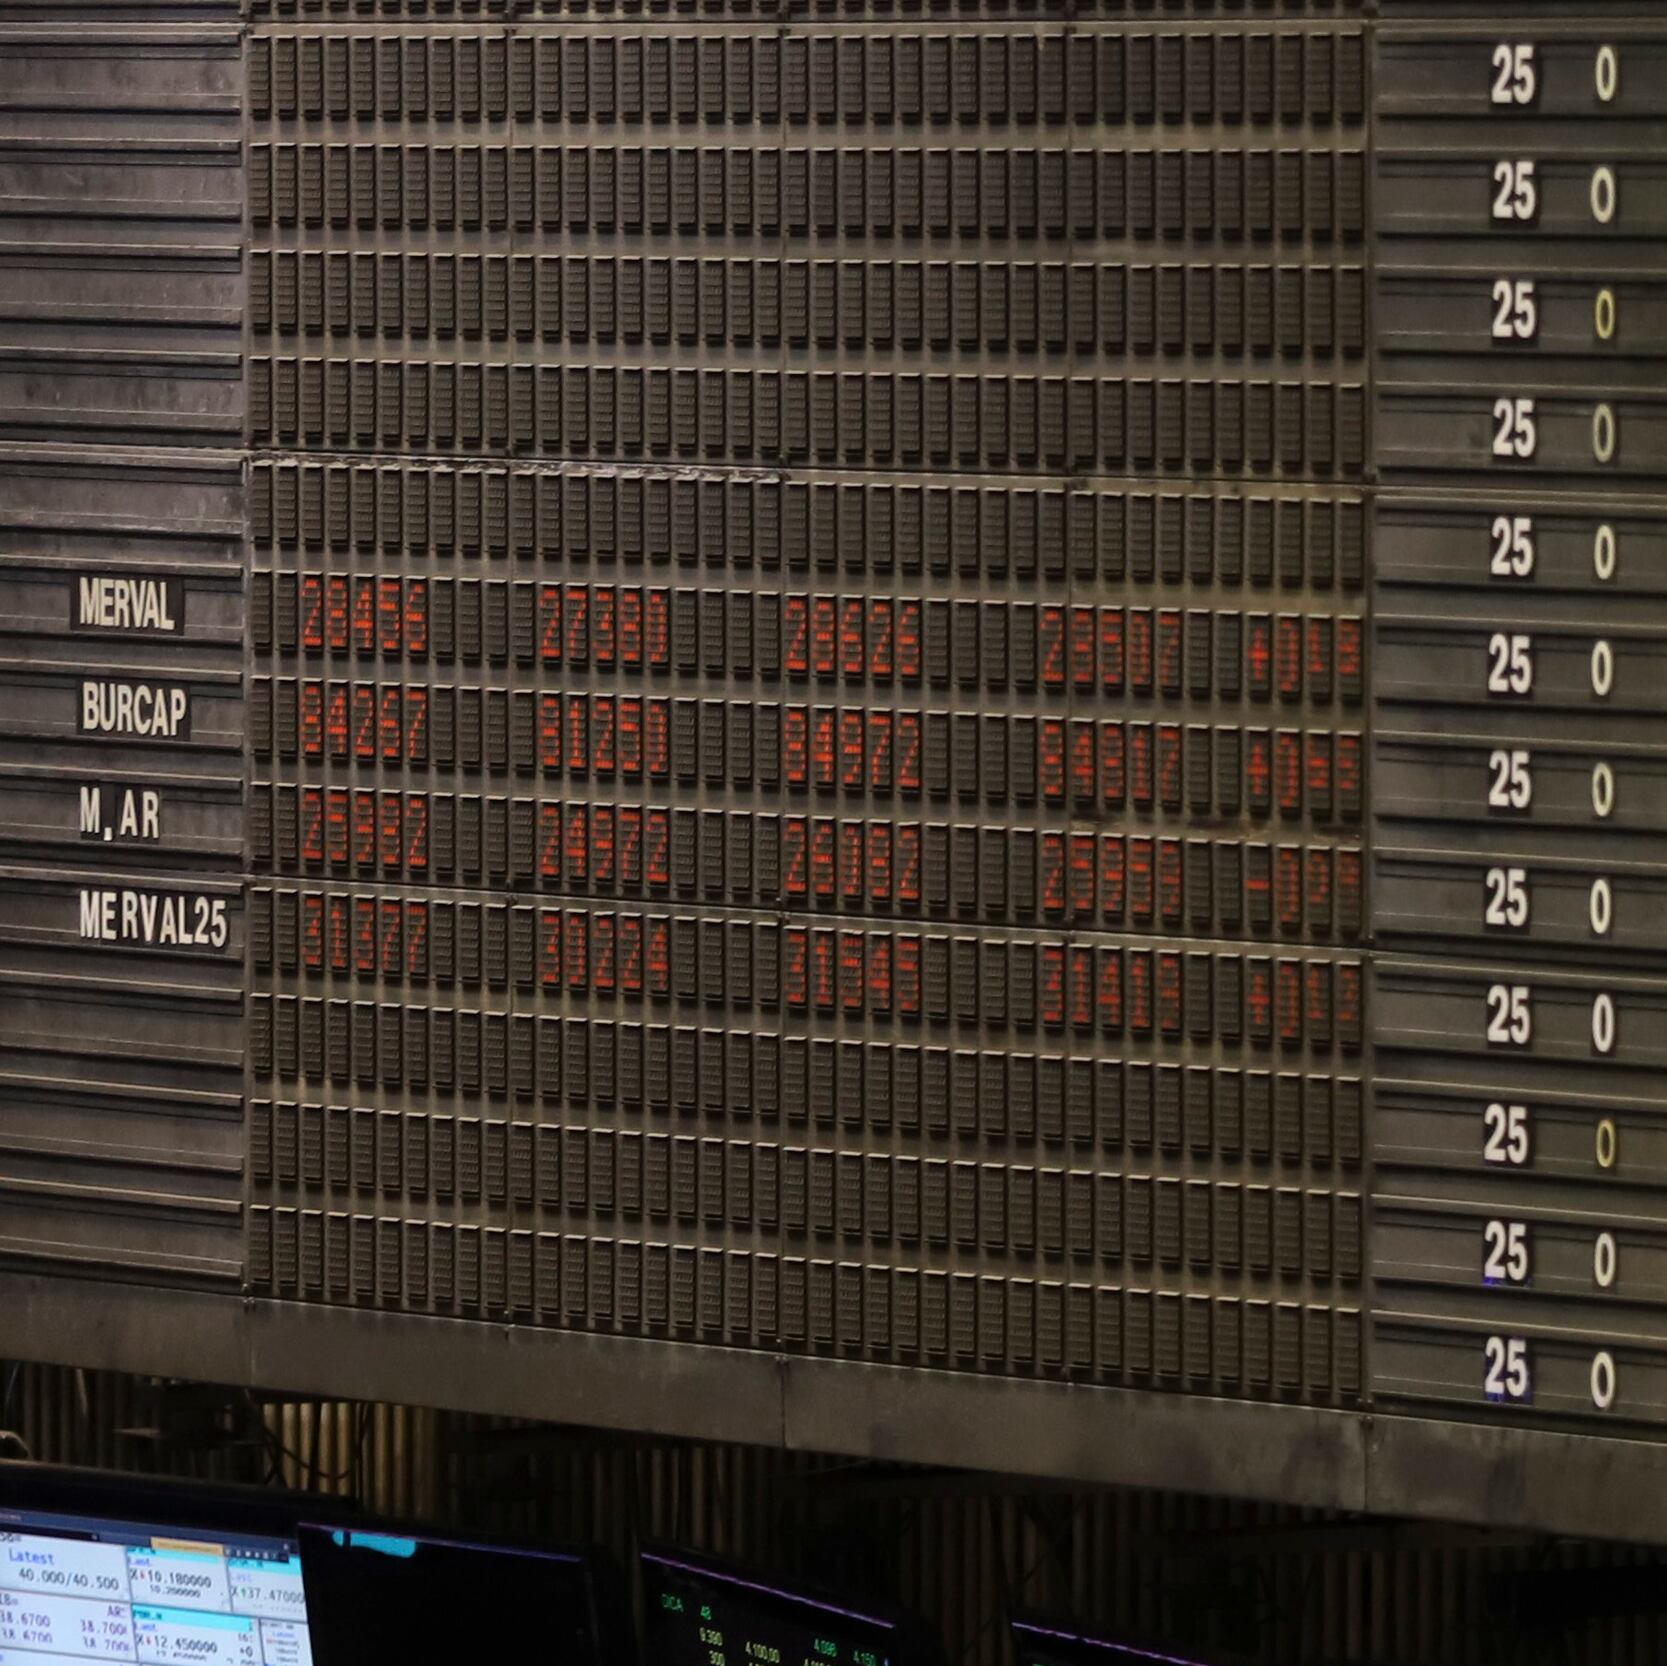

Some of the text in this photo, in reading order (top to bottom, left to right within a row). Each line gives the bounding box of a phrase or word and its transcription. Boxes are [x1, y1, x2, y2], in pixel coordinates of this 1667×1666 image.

[1490, 41, 1537, 106] 25
[1492, 158, 1538, 221] 25
[1491, 277, 1538, 340] 25
[1491, 395, 1537, 459] 25
[1490, 514, 1535, 578] 25
[79, 576, 175, 631] MERVAL
[1487, 630, 1534, 695] 25
[82, 681, 188, 738] BURCAP
[1488, 748, 1533, 810] 25
[79, 889, 228, 948] MERVAL25
[1485, 866, 1530, 928] 25
[1486, 982, 1532, 1046] 25
[1483, 1101, 1530, 1166] 25
[1483, 1218, 1530, 1282] 25
[1483, 1334, 1530, 1399] 25
[9, 1549, 55, 1565] Latest
